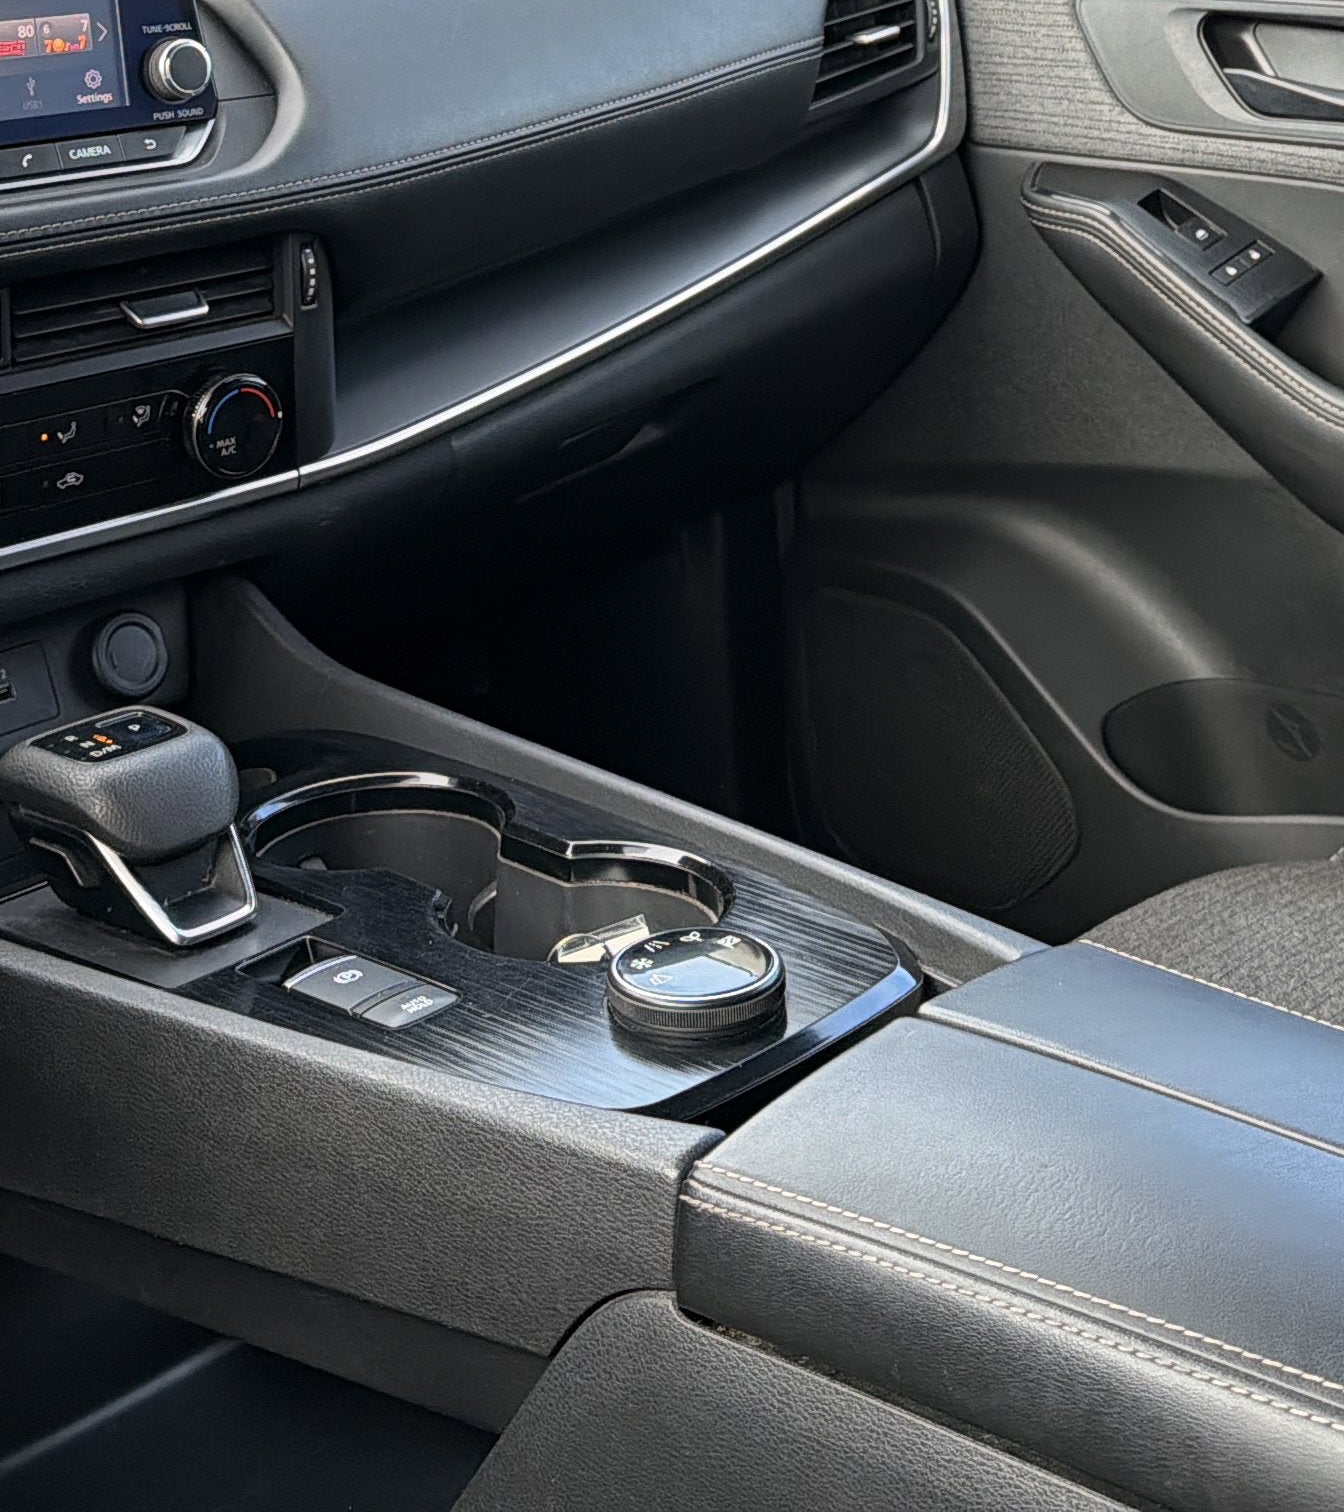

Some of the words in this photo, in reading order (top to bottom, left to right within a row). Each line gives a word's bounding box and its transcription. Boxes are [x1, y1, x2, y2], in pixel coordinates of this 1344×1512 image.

[17, 25, 35, 38] 80
[42, 24, 50, 34] 6
[80, 20, 89, 32] 7
[77, 92, 113, 105] Settings
[153, 109, 175, 121] PUSH
[177, 107, 205, 119] SOUND
[69, 144, 112, 160] CAMERA
[216, 436, 237, 449] MAX
[220, 445, 237, 457] A/C
[400, 995, 426, 1009] AUTO
[406, 998, 434, 1013] HOLD
